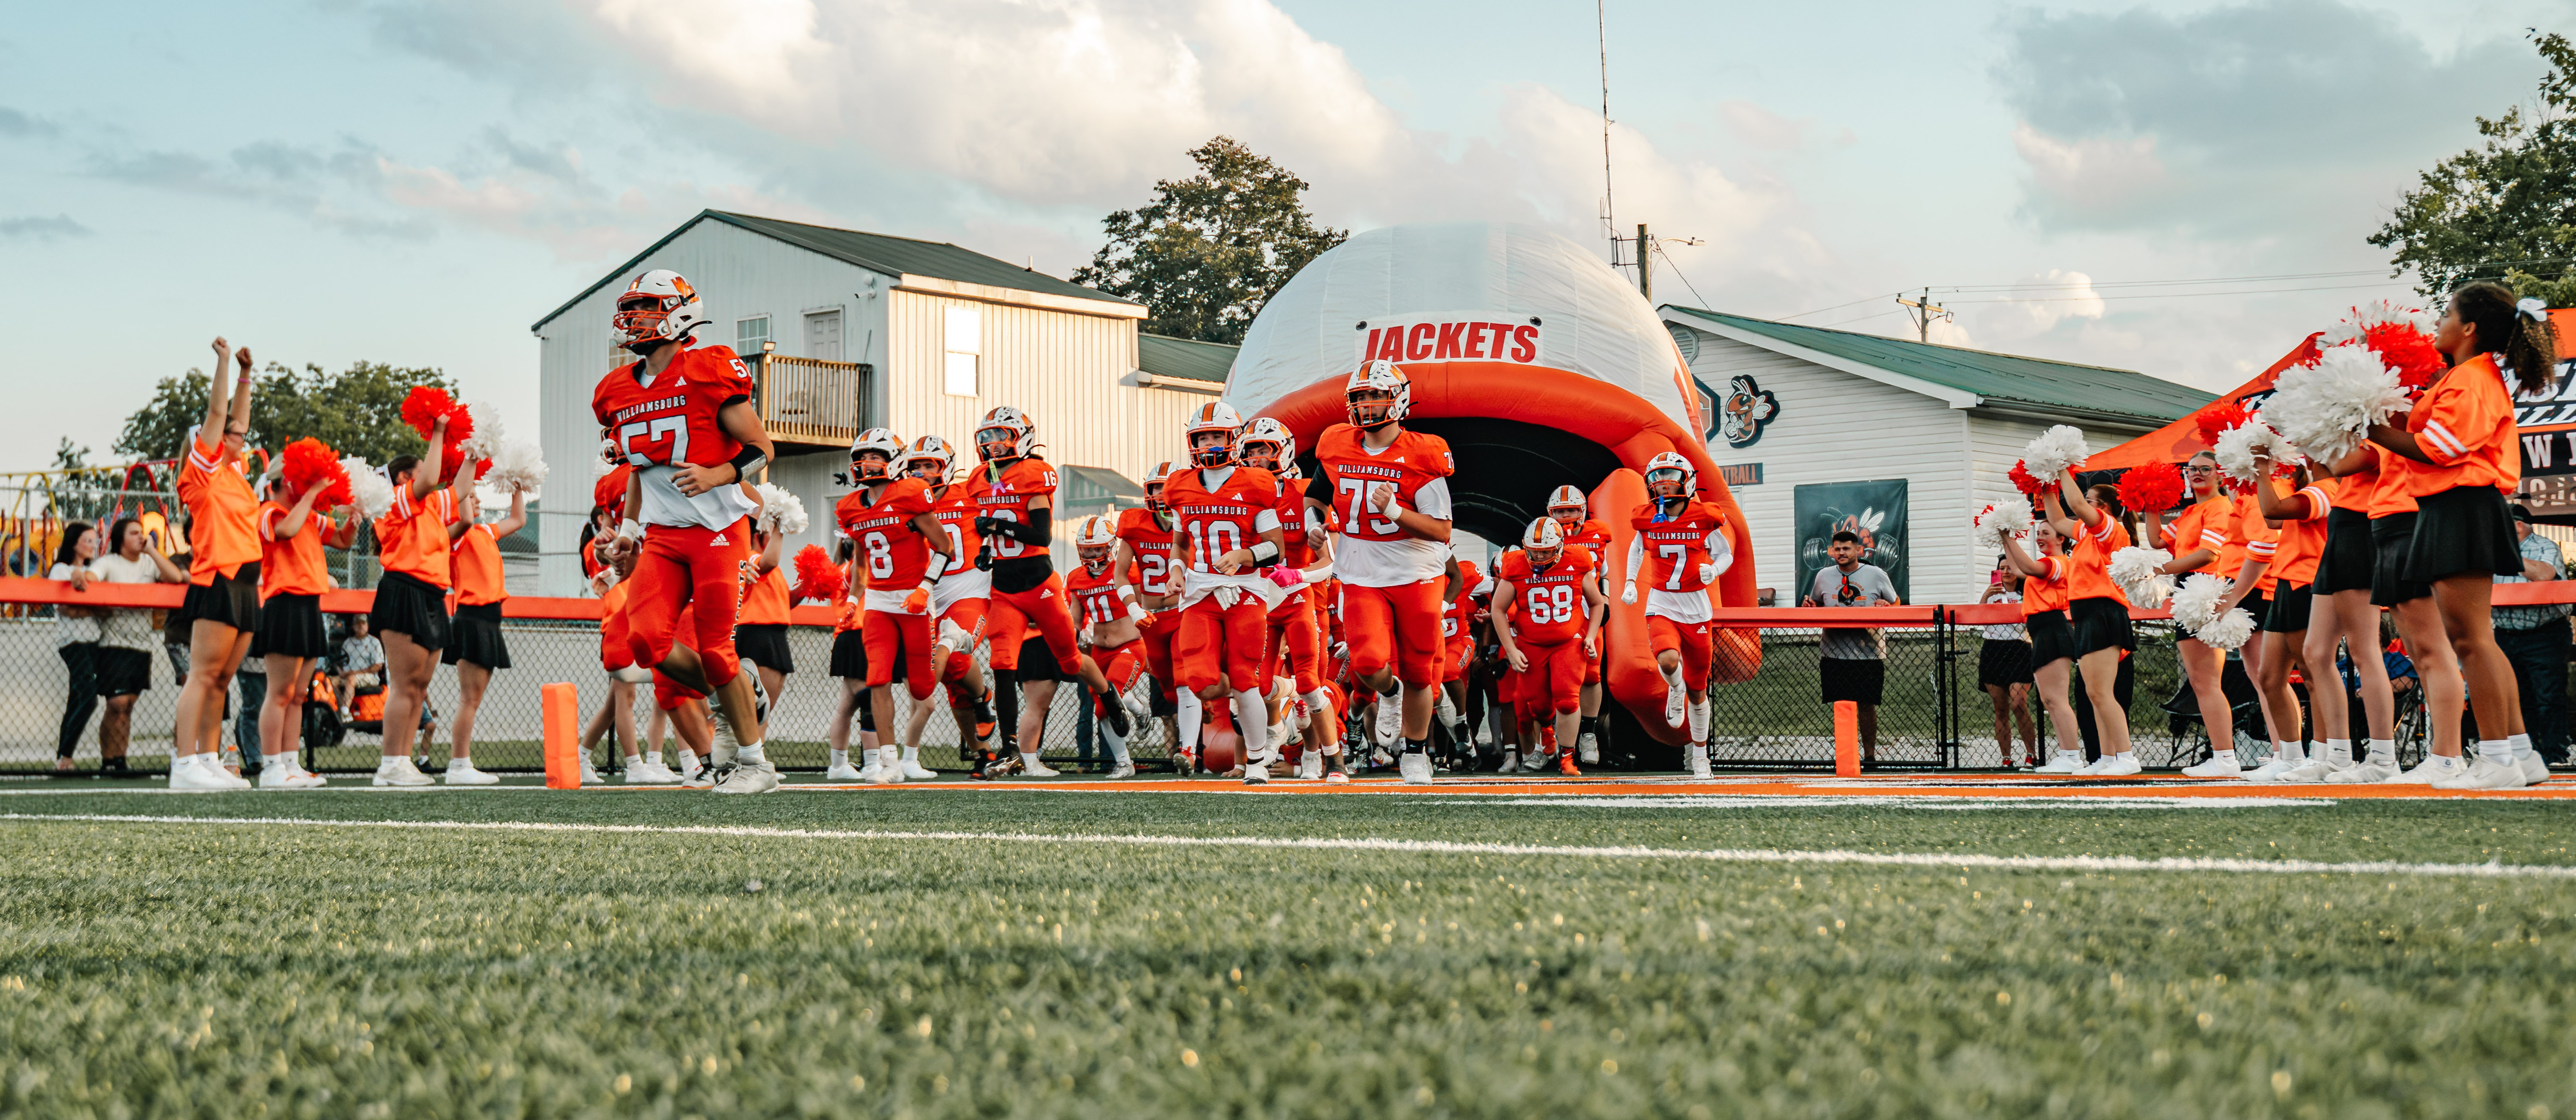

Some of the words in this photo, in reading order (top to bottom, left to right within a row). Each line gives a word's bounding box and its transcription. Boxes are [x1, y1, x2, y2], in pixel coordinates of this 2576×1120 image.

[1362, 322, 1538, 363] JACKETS
[621, 414, 689, 467] 57
[1042, 471, 1057, 487] 16
[1338, 464, 1402, 479] WILLIAMSBURG
[924, 488, 933, 504] 8
[1182, 506, 1247, 515] WILLIAMSBURG
[1339, 477, 1400, 535] 75
[864, 531, 894, 579] 8
[1188, 520, 1241, 573] 10
[1659, 544, 1687, 590] 7
[1087, 595, 1114, 623] 11
[1527, 585, 1573, 624] 68
